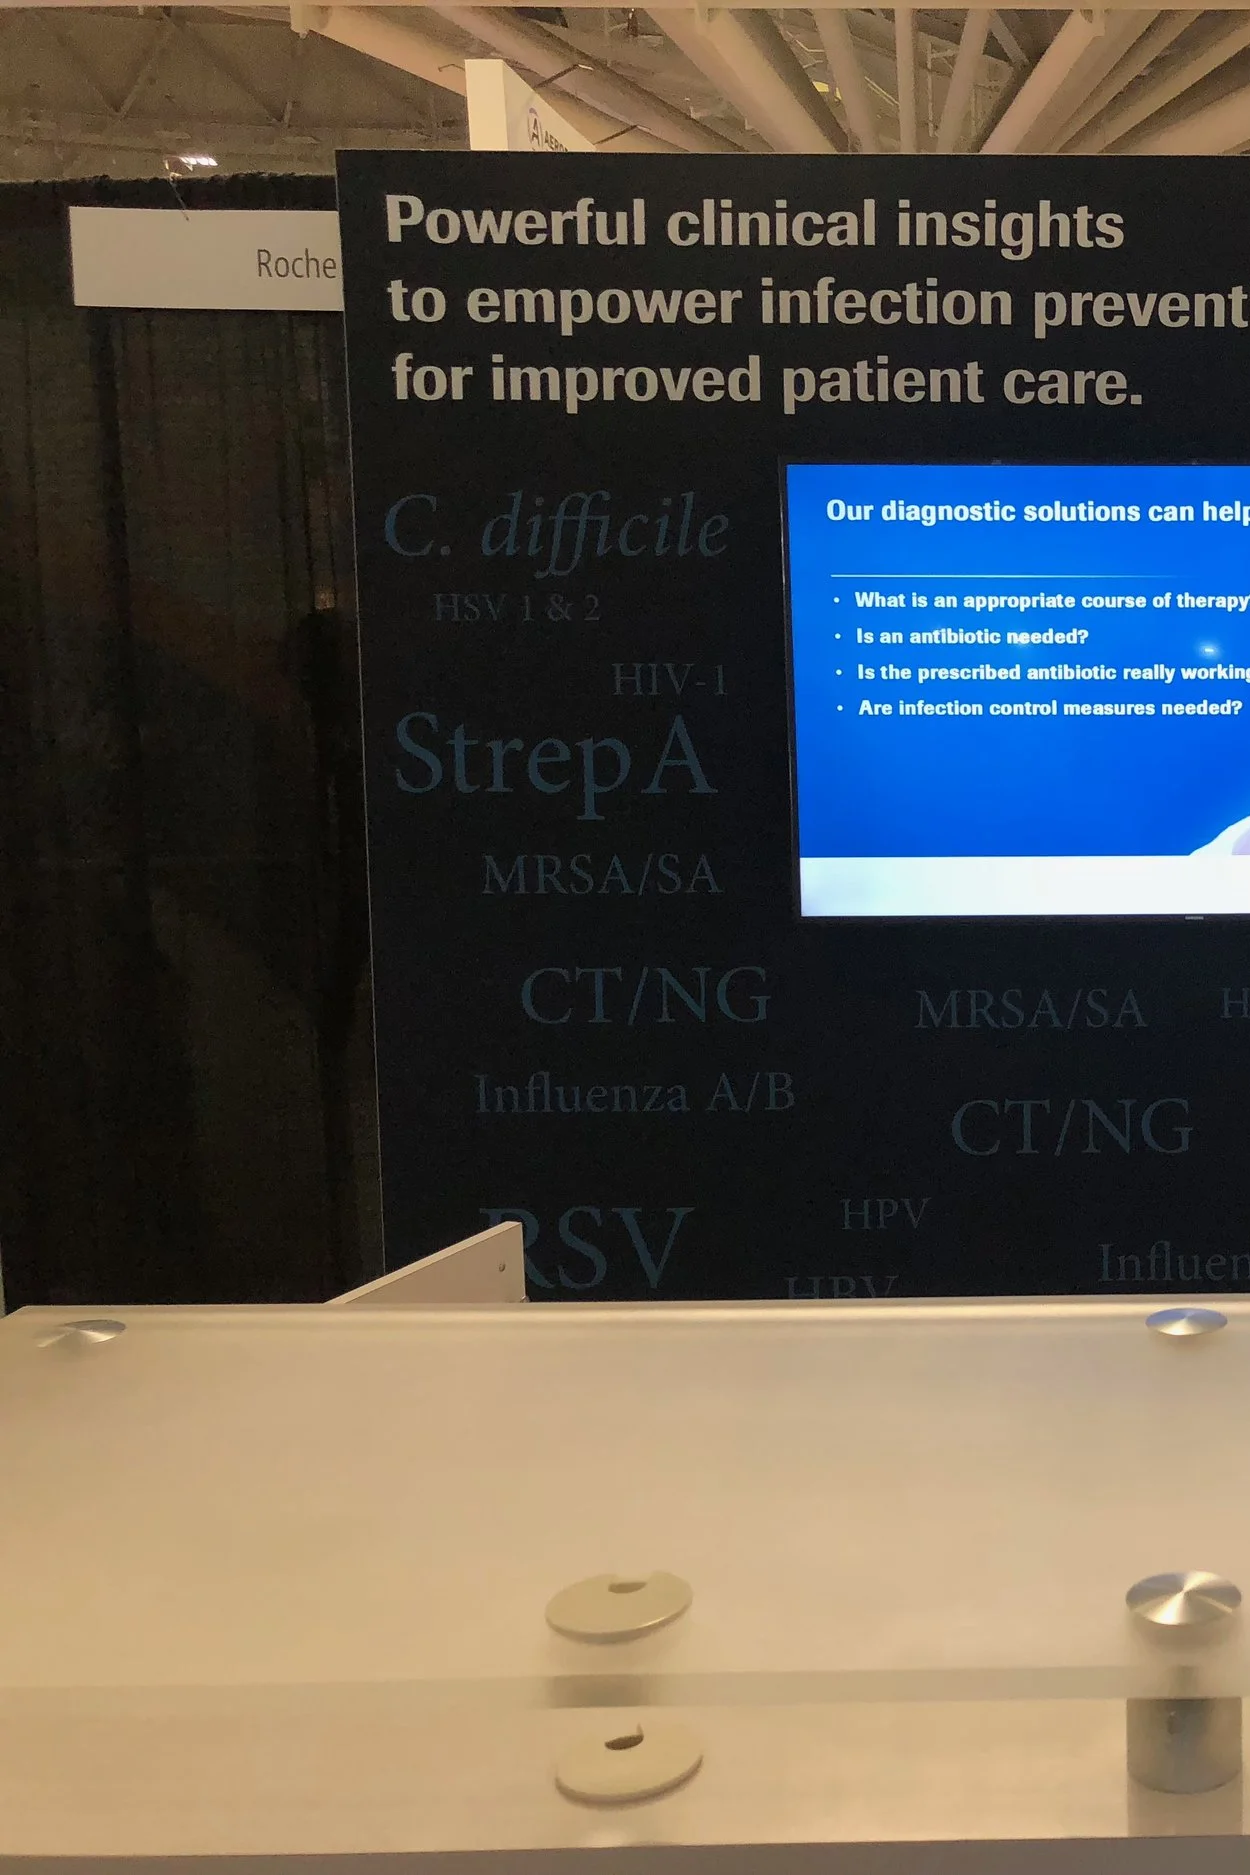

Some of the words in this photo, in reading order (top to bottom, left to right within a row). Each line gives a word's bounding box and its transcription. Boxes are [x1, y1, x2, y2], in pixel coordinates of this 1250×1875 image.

[386, 195, 645, 245] Powerful
[668, 199, 875, 246] clinical
[899, 200, 1124, 260] insights
[258, 248, 336, 279] Roche
[387, 280, 446, 322] to
[467, 288, 742, 336] empower
[762, 277, 1011, 325] infection
[392, 353, 473, 400] for
[492, 354, 760, 413] improved
[784, 356, 984, 414] patient
[1004, 369, 1142, 405] care.
[827, 500, 873, 520] Our
[882, 501, 1015, 526] diagnostic
[1024, 501, 1140, 521] solutions
[1149, 506, 1194, 521] can
[385, 494, 450, 556] C.
[482, 490, 728, 578] difficile
[434, 593, 505, 621] HSV
[523, 595, 531, 621] 1
[548, 594, 572, 621] &
[585, 594, 599, 620] 2
[855, 592, 905, 607] What
[912, 593, 927, 607] is
[934, 596, 957, 607] an
[964, 593, 1075, 612] appropriate
[1082, 596, 1146, 608] course
[1153, 593, 1171, 607] of
[857, 629, 873, 643] Is
[880, 633, 903, 643] an
[910, 628, 1000, 643] antibiotic
[1007, 629, 1088, 644] needed?
[611, 662, 727, 697] HIV-1
[858, 664, 874, 679] Is
[881, 665, 911, 679] the
[918, 664, 1020, 683] prescribed
[1027, 665, 1116, 679] antibiotic
[1124, 664, 1175, 683] really
[859, 700, 892, 715] Are
[900, 700, 983, 715] infection
[990, 700, 1057, 715] control
[1064, 704, 1155, 715] measures
[1162, 700, 1242, 715] needed?
[396, 712, 631, 820] Strep
[641, 715, 718, 793] A
[483, 854, 721, 895] MRSA/SA
[521, 966, 770, 1025] CT/NG
[916, 989, 1147, 1029] MRSA/SA
[475, 1071, 690, 1112] Influenza
[707, 1072, 794, 1112] A/B
[951, 1098, 1193, 1156] CT/NG
[842, 1198, 930, 1229] HPV
